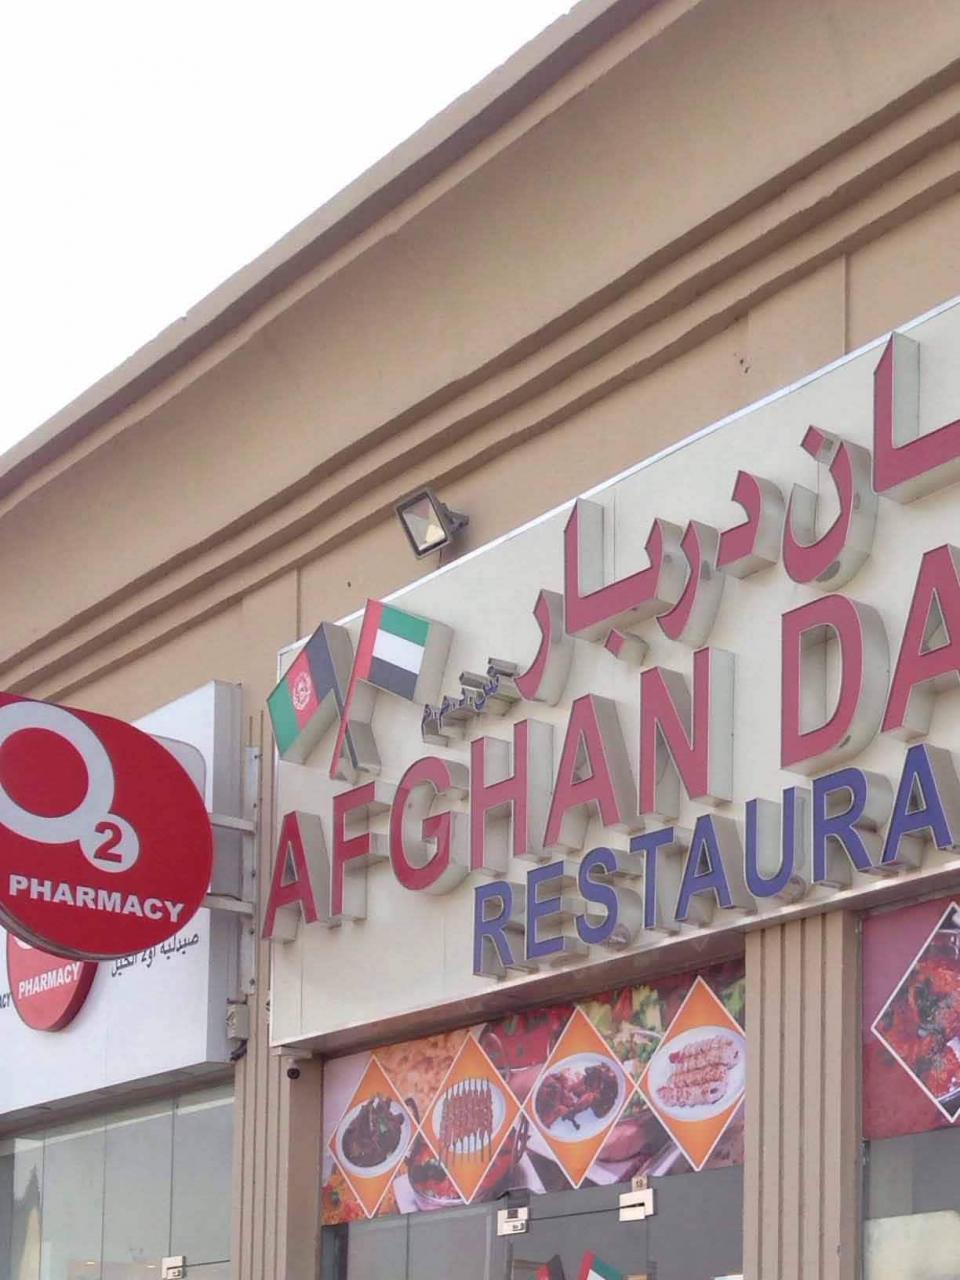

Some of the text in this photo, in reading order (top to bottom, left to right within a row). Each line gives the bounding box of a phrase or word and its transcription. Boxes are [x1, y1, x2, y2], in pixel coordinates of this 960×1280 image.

[513, 469, 763, 700] دربار
[262, 646, 711, 941] AFGHAN
[9, 873, 185, 923] PHARMACY
[18, 961, 81, 1000] PHARMACY
